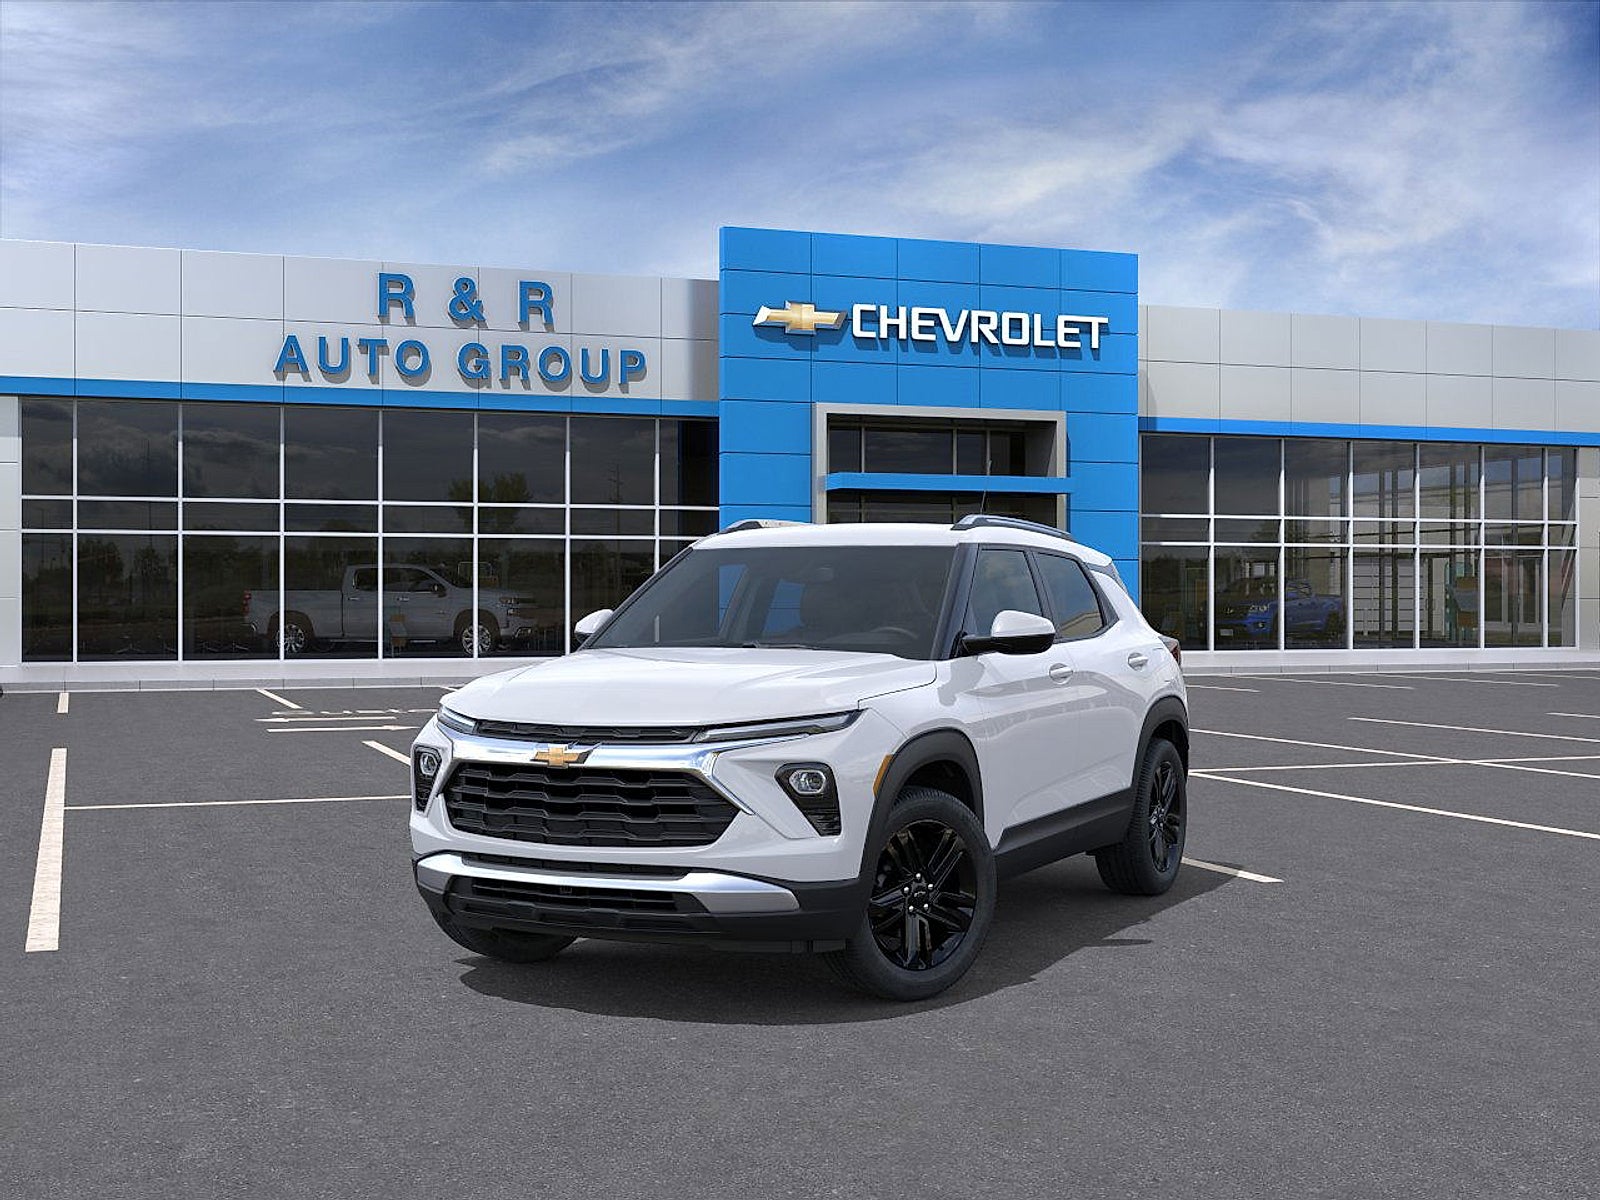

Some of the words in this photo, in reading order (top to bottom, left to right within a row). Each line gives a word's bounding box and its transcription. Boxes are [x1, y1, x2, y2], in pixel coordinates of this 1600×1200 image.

[378, 272, 415, 319] R
[447, 277, 486, 321] &
[518, 280, 554, 325] R
[852, 303, 1109, 349] CHEVROLET
[274, 334, 431, 377] AUTO
[457, 342, 646, 386] GROUP
